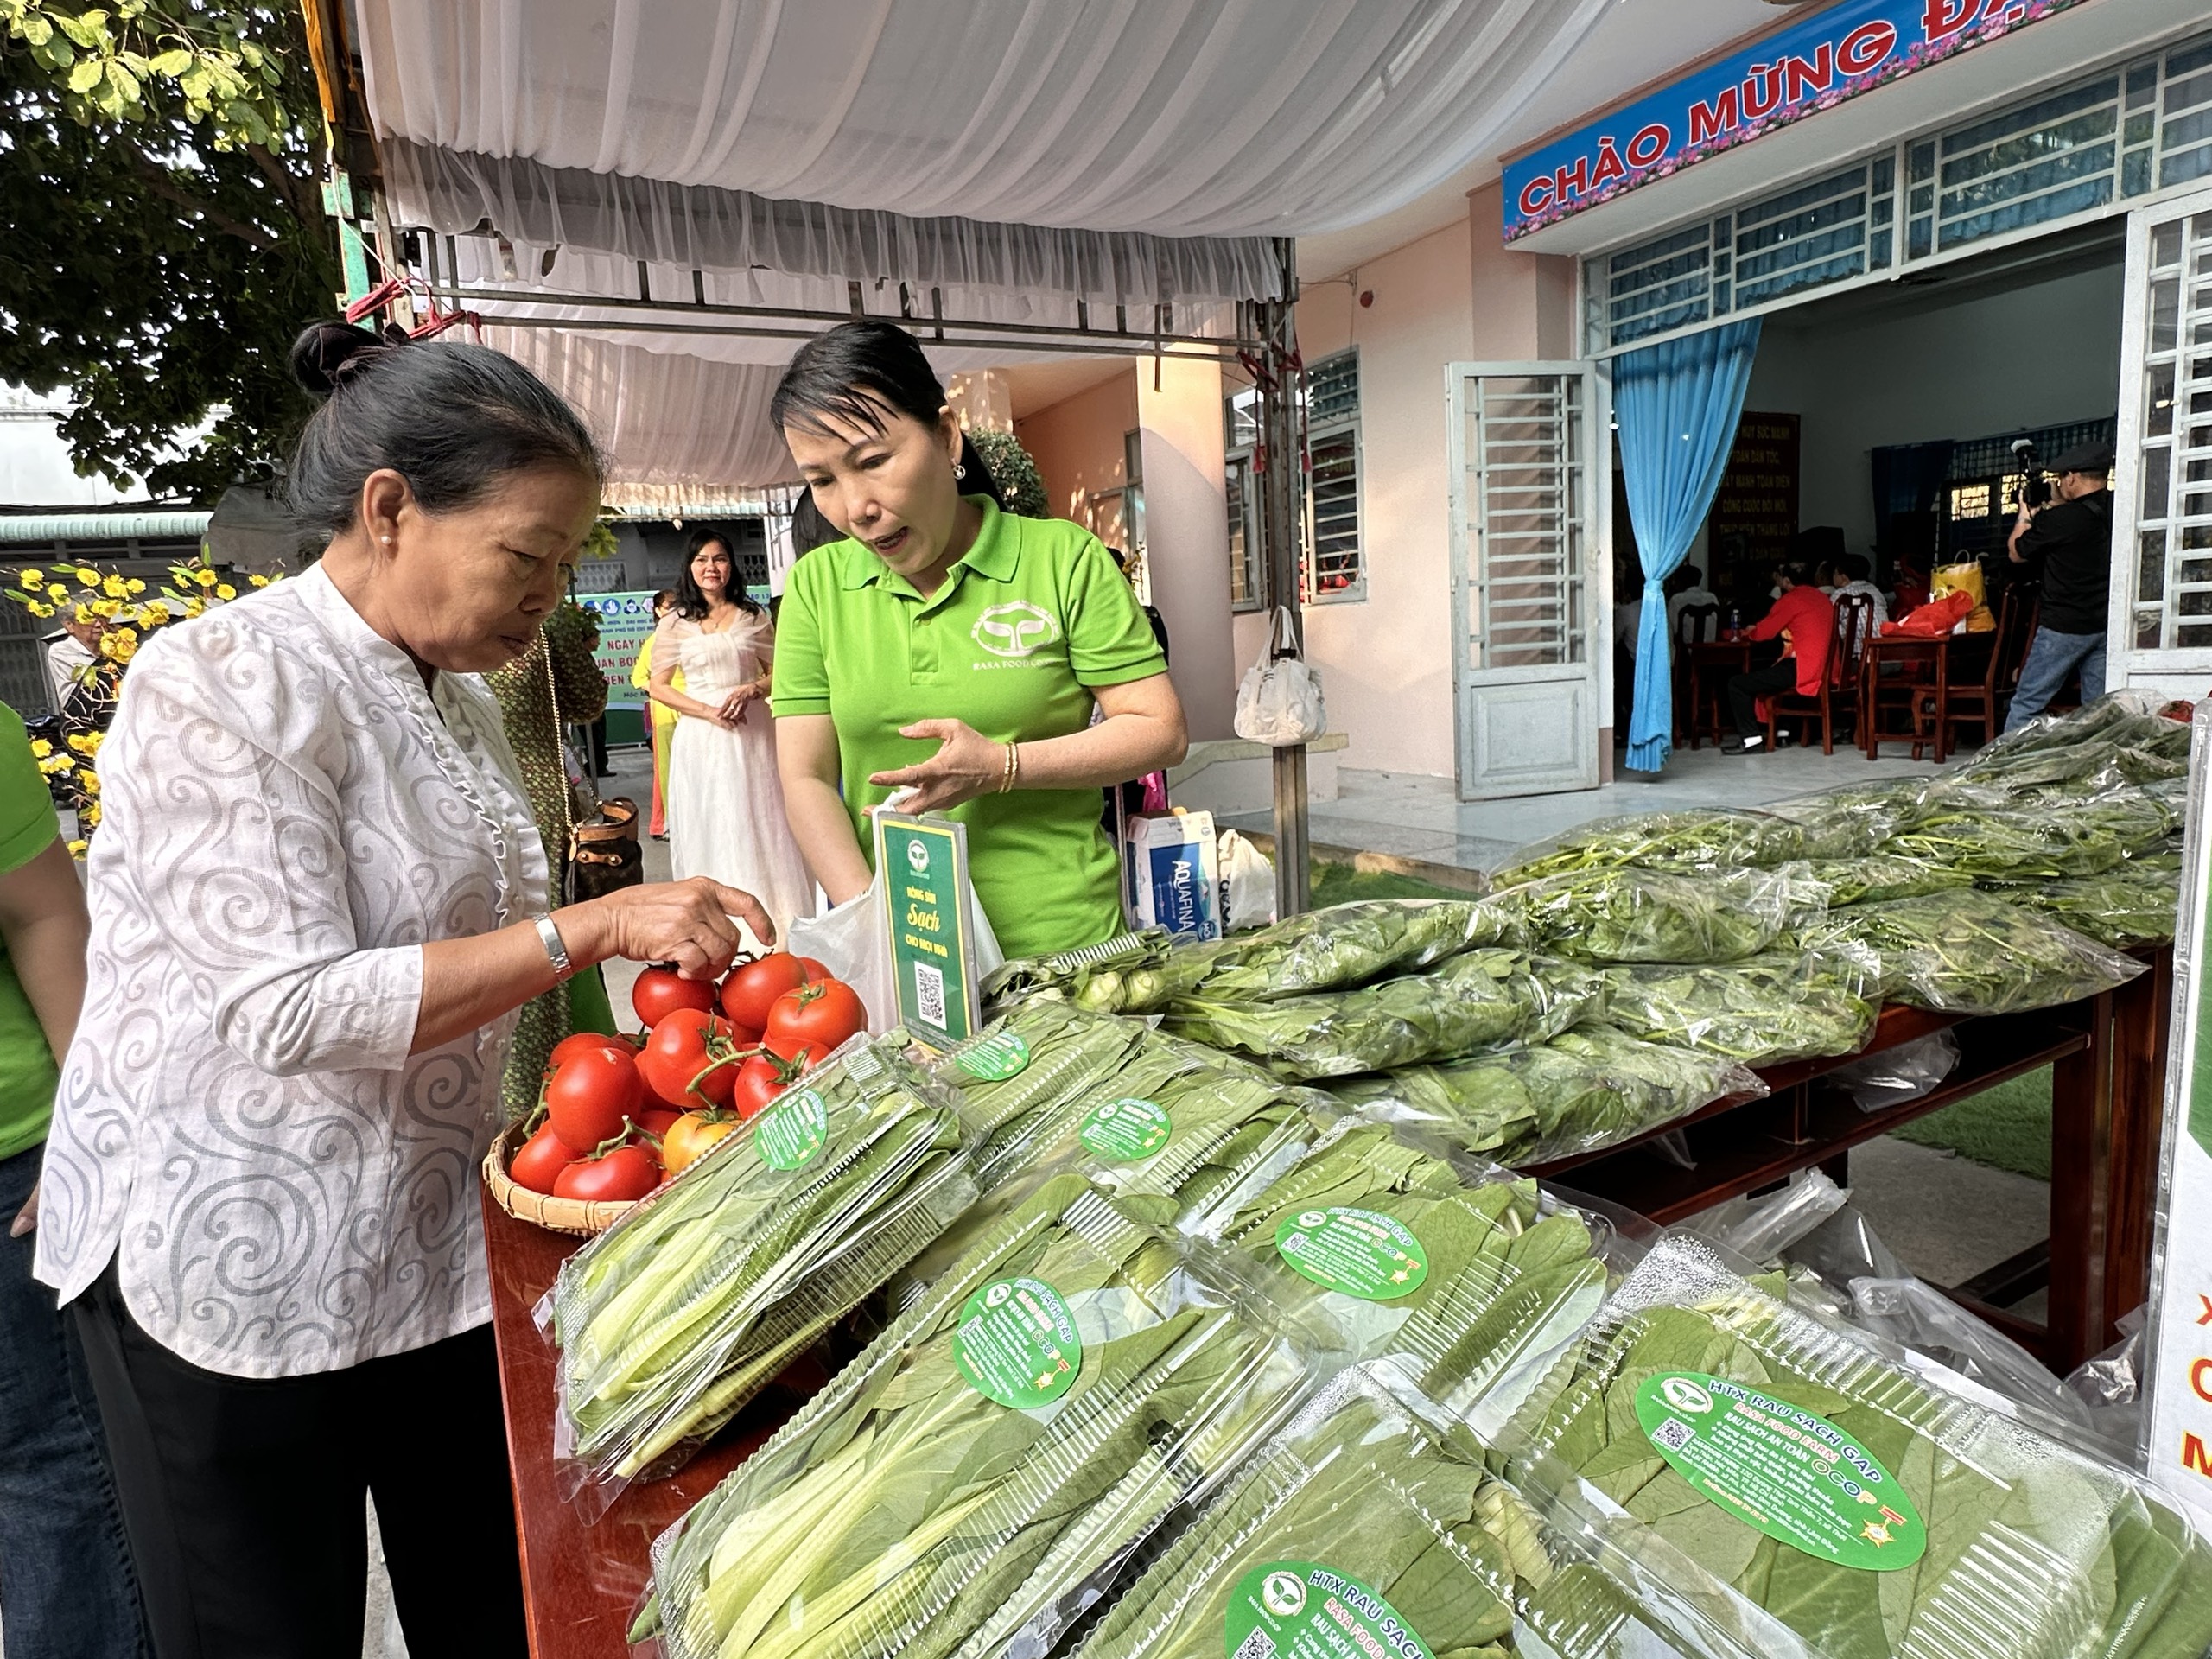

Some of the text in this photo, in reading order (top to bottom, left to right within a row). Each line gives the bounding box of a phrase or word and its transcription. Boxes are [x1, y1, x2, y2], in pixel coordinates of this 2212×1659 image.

[1519, 123, 1671, 217] CHÀO
[1688, 19, 1898, 147] MỪNG
[973, 662, 1000, 671] RASA
[1002, 659, 1029, 668] FOOD
[1172, 860, 1197, 932] AQUAFINA
[907, 903, 941, 933] Sạch
[1391, 1223, 1414, 1247] GAP
[1032, 1329, 1062, 1360] OCOP
[1056, 1315, 1074, 1344] GAP
[1709, 1380, 1749, 1401] HTX
[1751, 1396, 1792, 1417] RAU
[1792, 1414, 1843, 1446] SẠCH
[1841, 1444, 1883, 1482] GAP
[1724, 1412, 1810, 1462] RAU SẠCH AN TOÀN
[1733, 1402, 1840, 1464] RASA FOOD FARM
[1814, 1462, 1878, 1504] OCOP
[1309, 1571, 1346, 1594] HTX
[1343, 1586, 1385, 1621] RAU
[1324, 1597, 1356, 1630] RASA
[1311, 1613, 1331, 1635] RAU
[1327, 1630, 1351, 1656] SẠCH
